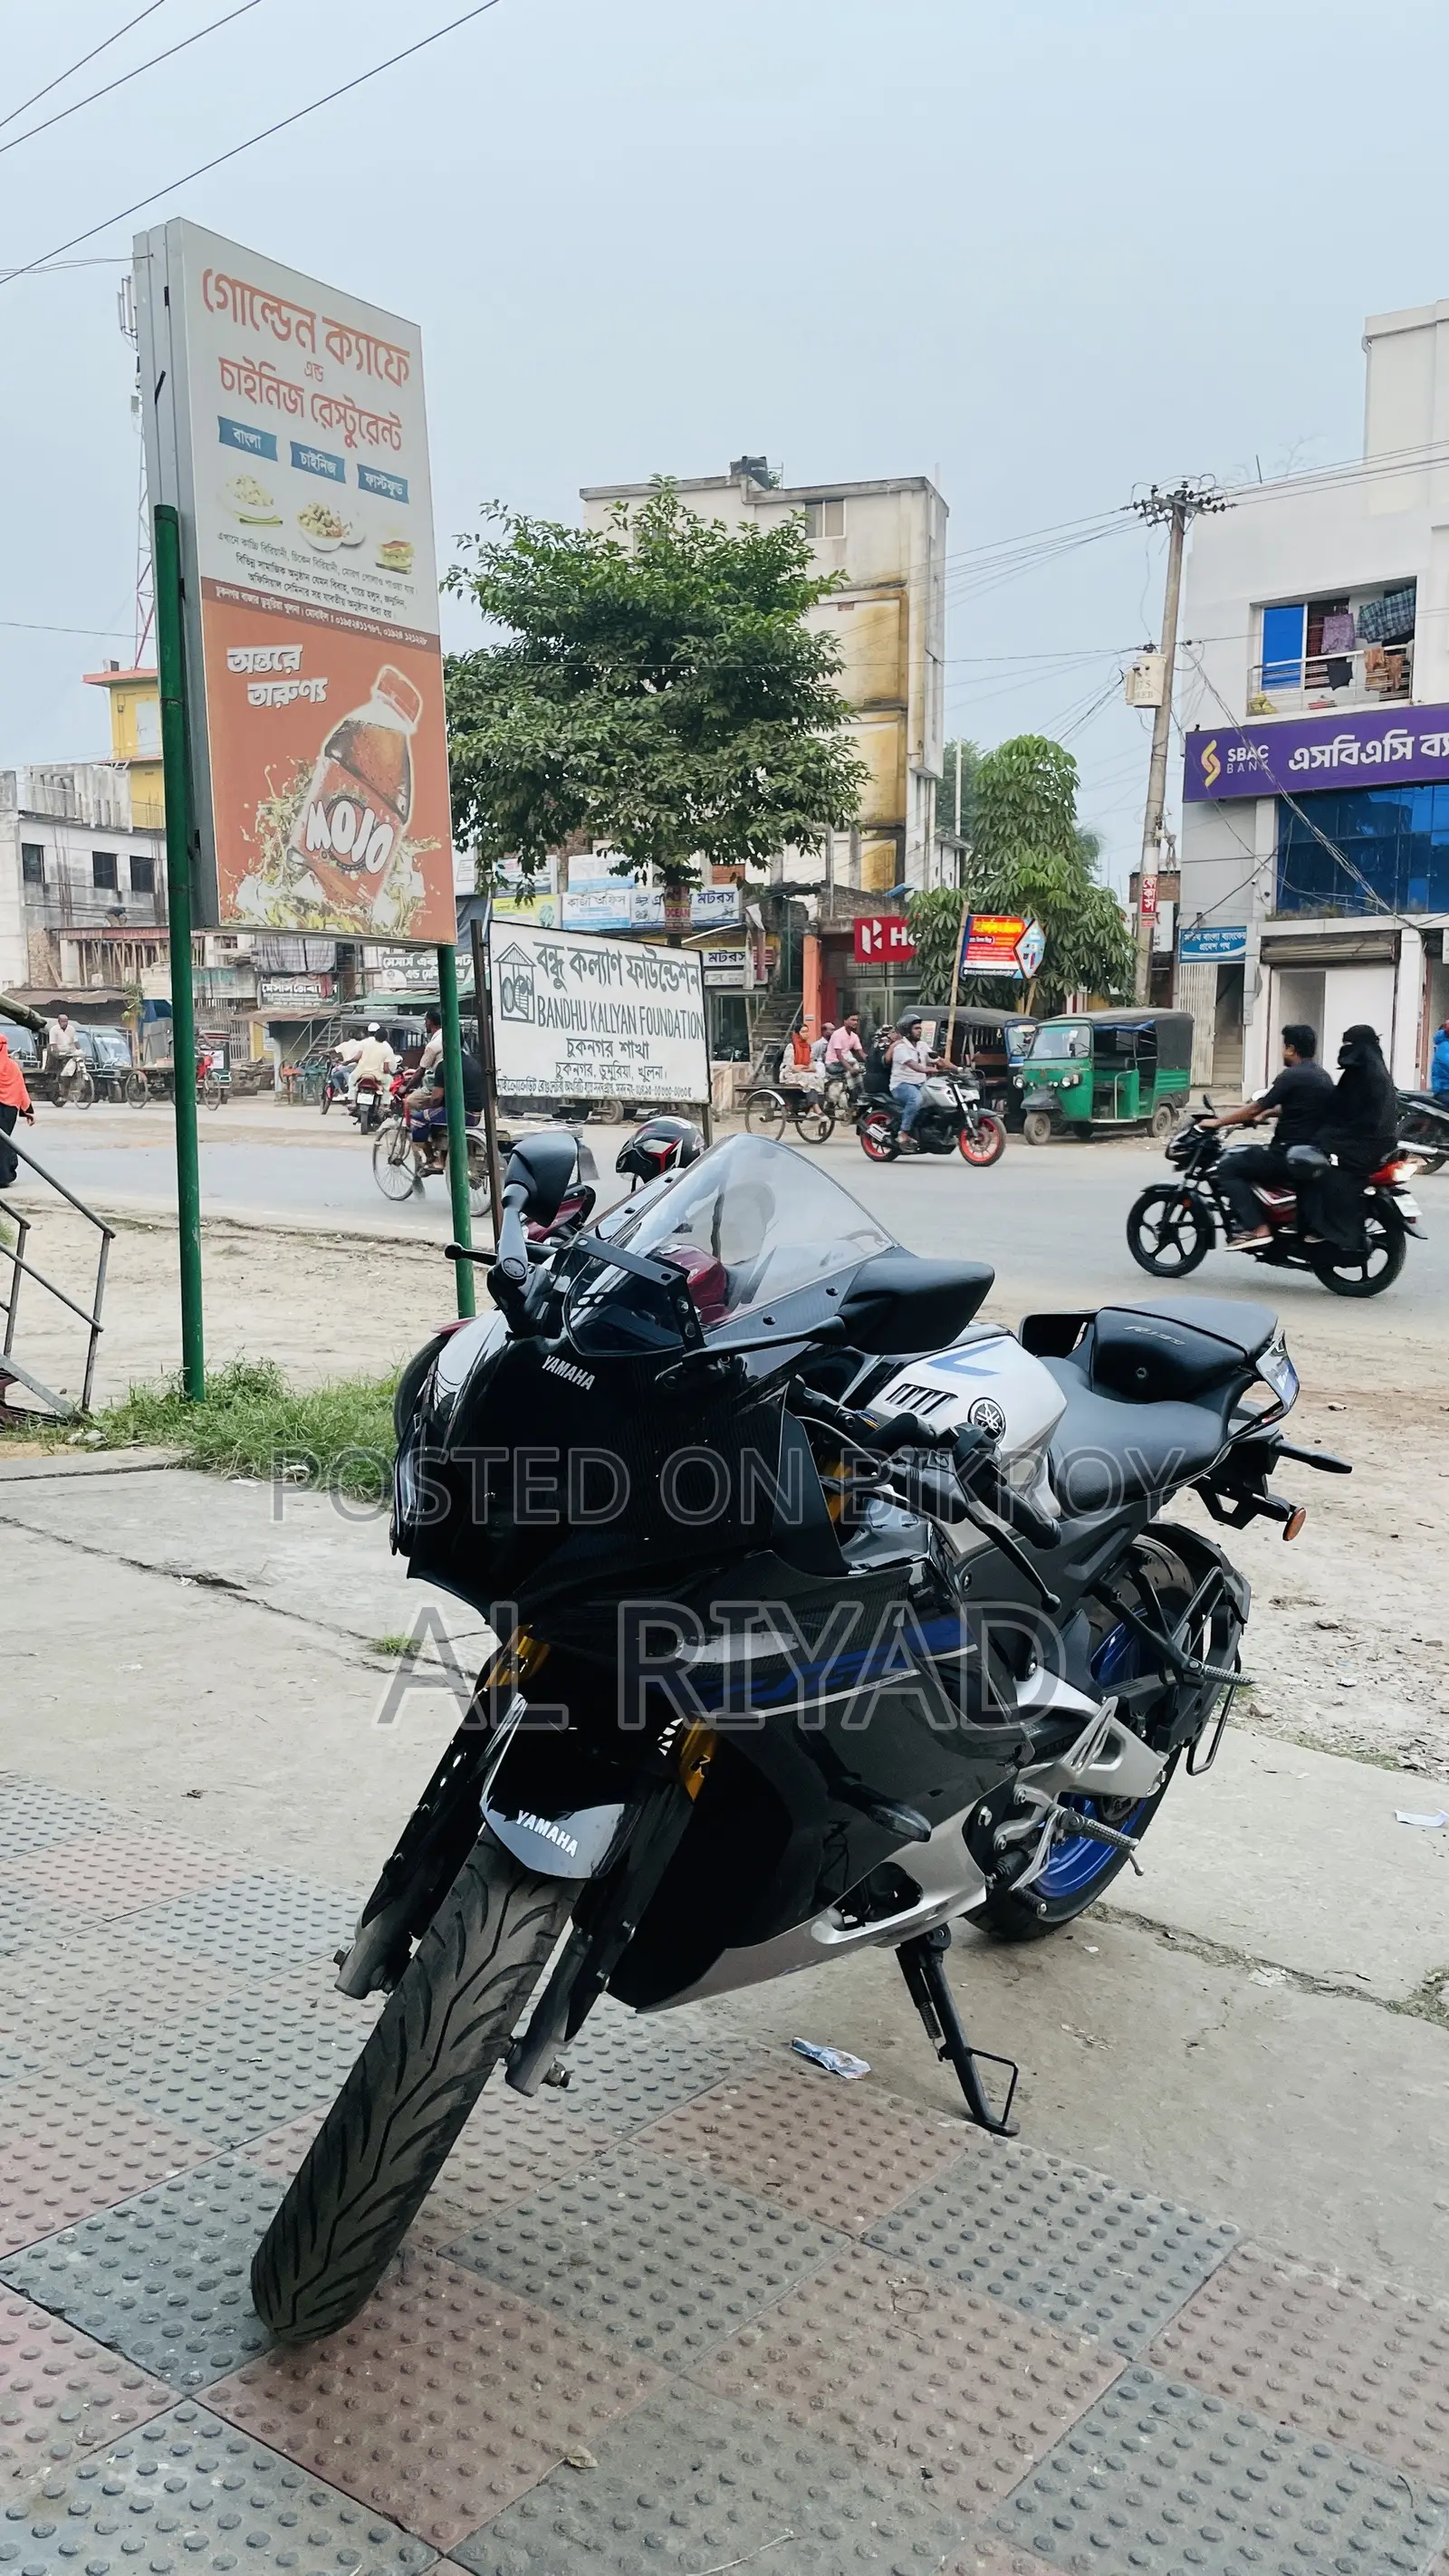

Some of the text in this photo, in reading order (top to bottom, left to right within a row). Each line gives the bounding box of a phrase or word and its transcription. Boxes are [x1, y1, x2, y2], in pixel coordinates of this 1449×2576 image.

[203, 268, 410, 388] গোল্ডেন ক্যাফে
[218, 356, 402, 451] চাইনিজ রেস্টুরেন্ট
[233, 427, 262, 450] বাংলা
[299, 450, 337, 476] চাইনিজ
[226, 643, 303, 675] অন্তরে
[246, 677, 329, 709] তারুণ্য
[1227, 744, 1270, 762] SBAC
[1289, 729, 1415, 771] এসবিএসি
[304, 799, 395, 875] MOJO
[697, 890, 735, 905] মটরস
[533, 942, 702, 995] বন্ধু কল্যাণ ফাউন্ডেশন
[537, 995, 588, 1032] BANDHU
[640, 1006, 705, 1041] FOUNDATION
[566, 1038, 649, 1060] চুকনগর শাখা
[541, 1354, 596, 1391] YAMAHA
[515, 1809, 580, 1858] YAMAHA
